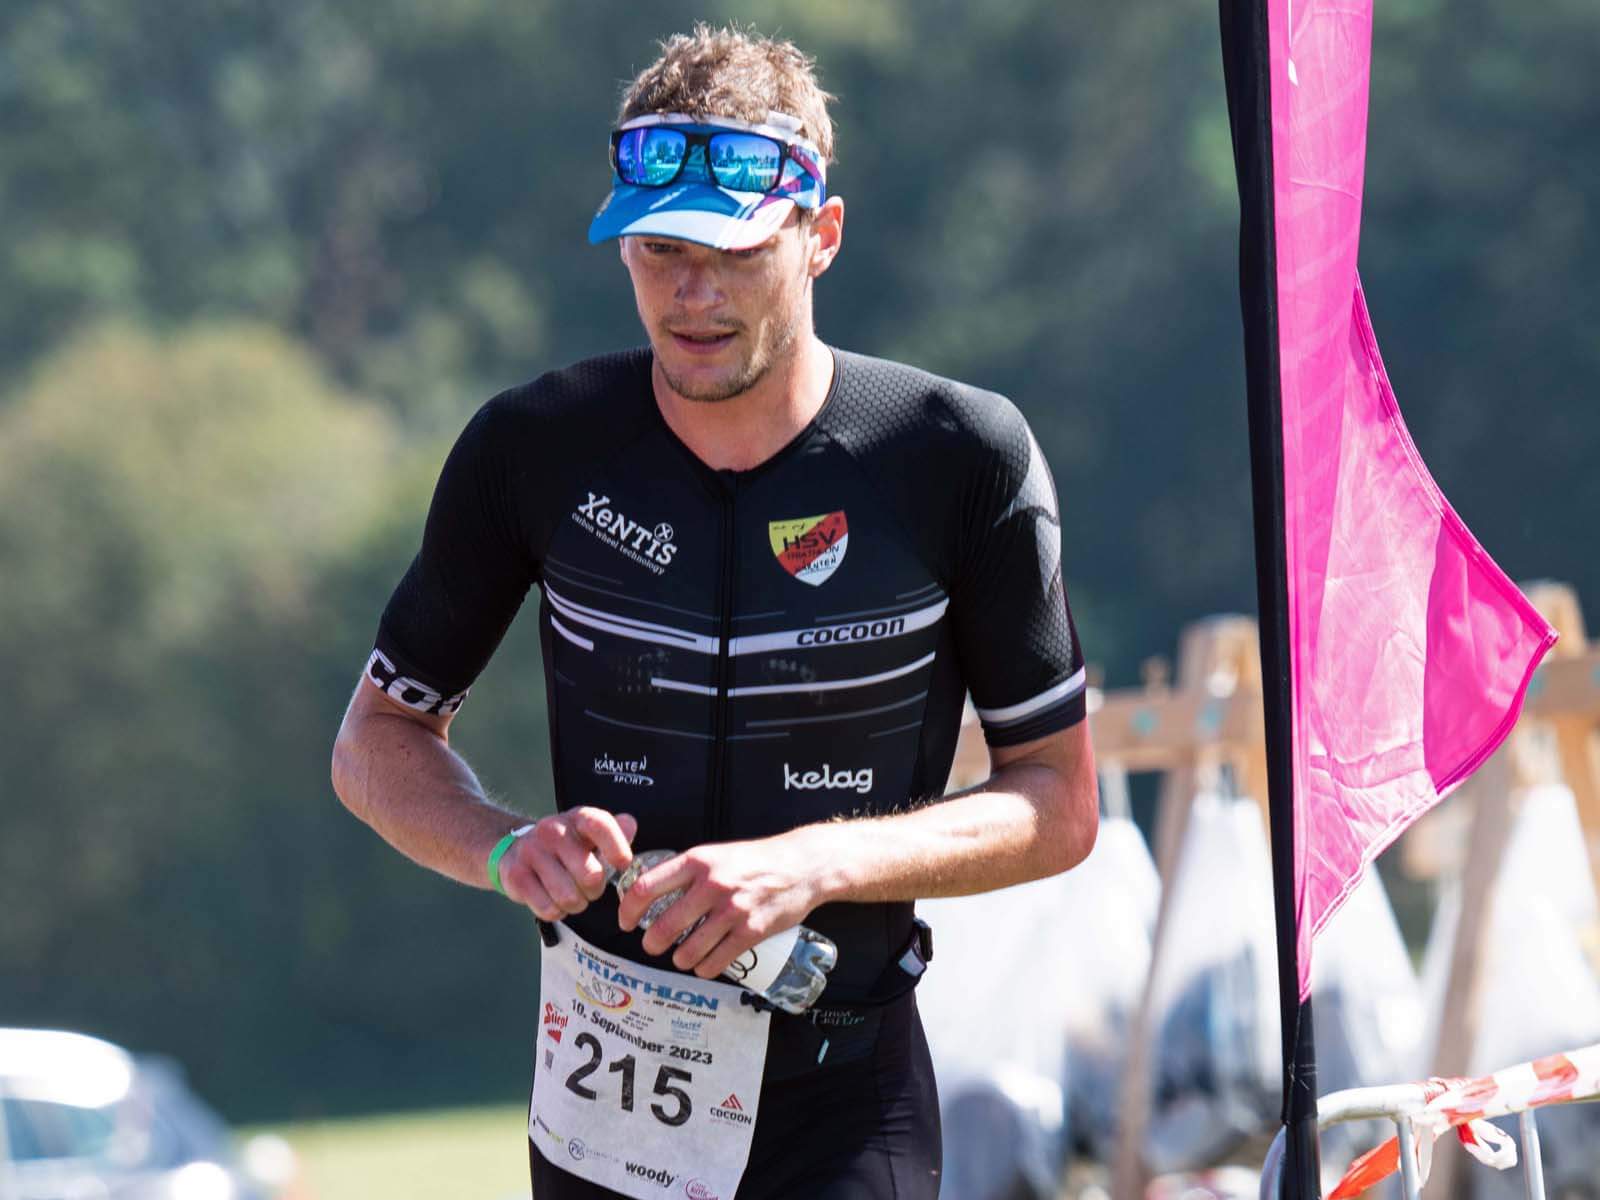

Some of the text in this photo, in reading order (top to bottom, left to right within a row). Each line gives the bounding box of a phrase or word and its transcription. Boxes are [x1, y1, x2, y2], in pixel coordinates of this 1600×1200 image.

[571, 512, 665, 575] carbon wheel technology
[783, 528, 837, 553] HSV
[796, 617, 905, 646] cocoon
[784, 762, 873, 794] kelag
[575, 951, 719, 1012] TRIATHLON
[543, 1001, 569, 1030] Stiegl
[687, 1008, 717, 1020] begann
[571, 998, 588, 1019] 10.
[590, 1010, 665, 1054] September
[669, 1045, 713, 1066] 2023
[565, 1031, 693, 1128] 215
[709, 1107, 752, 1126] COCOON
[625, 1161, 675, 1189] woody
